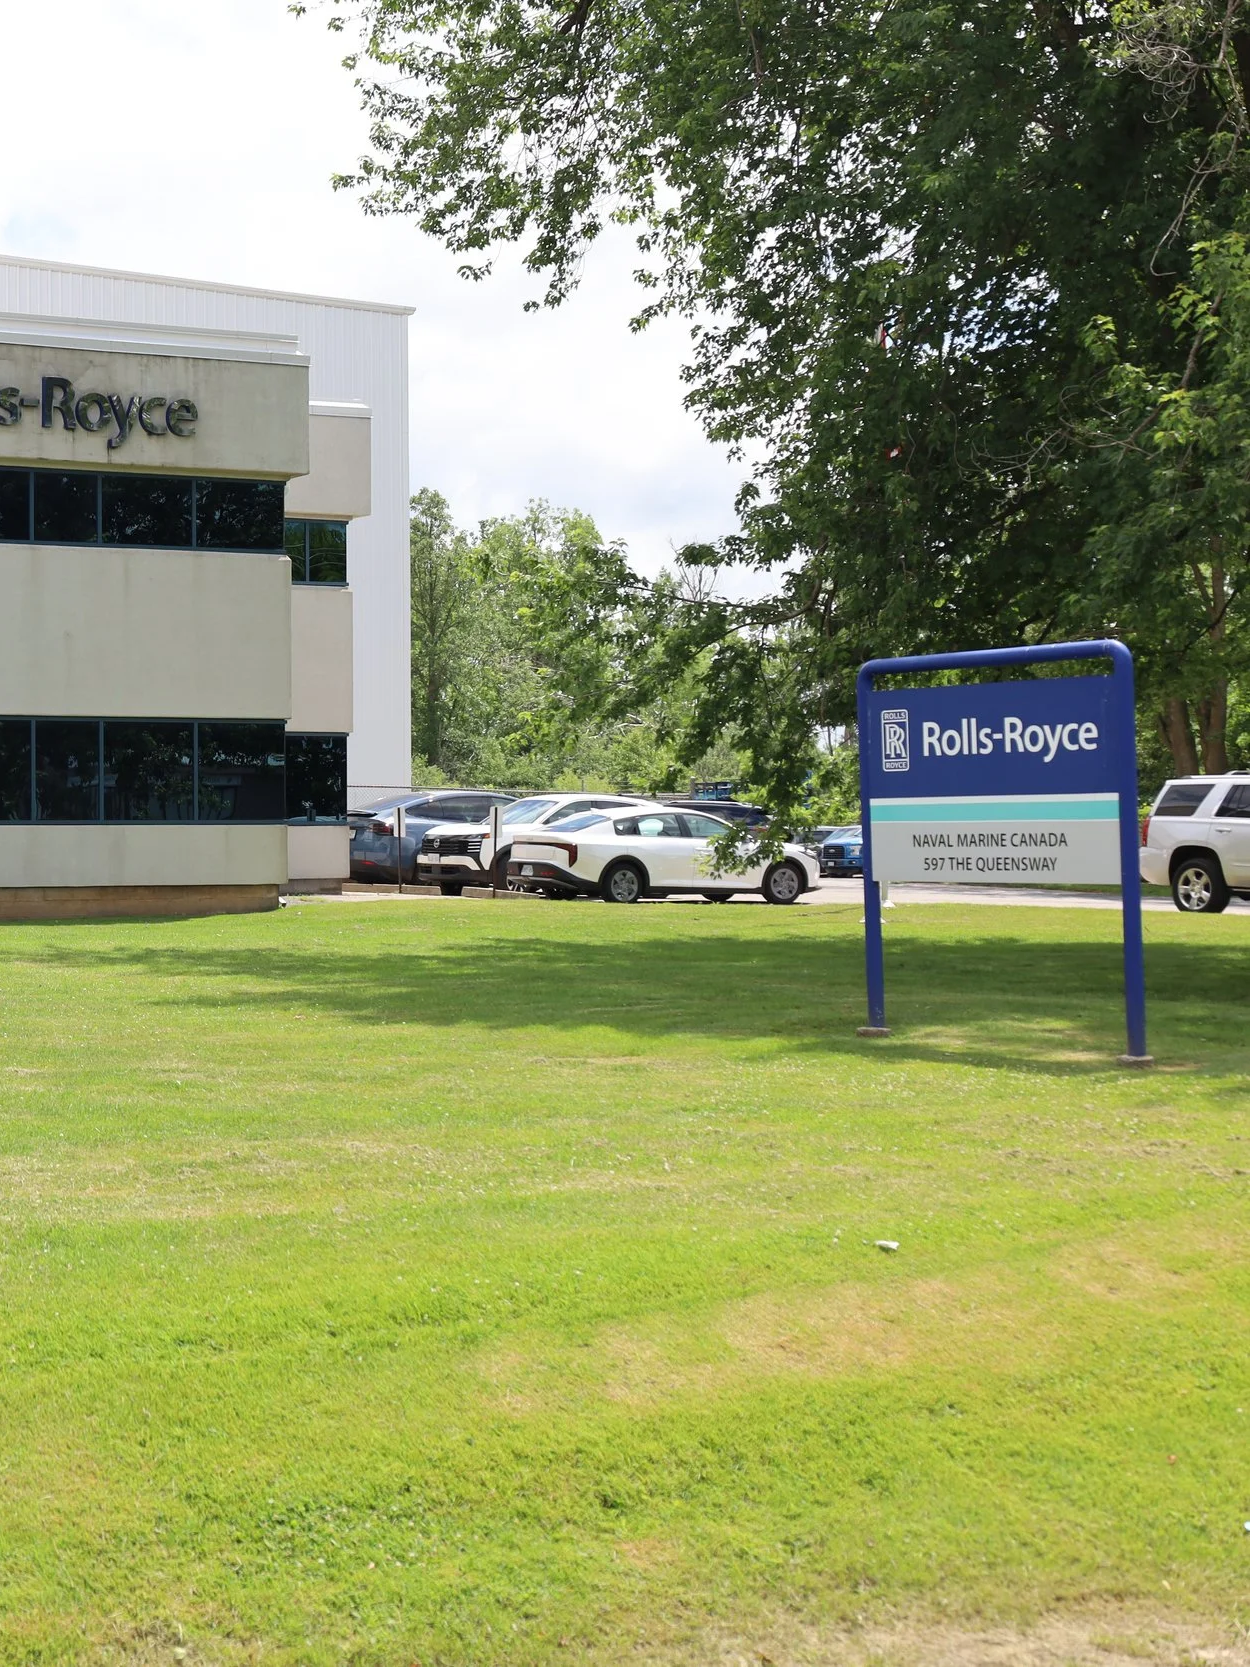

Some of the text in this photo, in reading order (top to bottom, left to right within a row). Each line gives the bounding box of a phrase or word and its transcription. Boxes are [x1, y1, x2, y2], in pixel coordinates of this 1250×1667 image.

[884, 712, 905, 720] ROLLS
[922, 717, 1098, 763] Rolls-Royce
[912, 832, 1068, 848] NAVAL MARINE CANADA
[923, 857, 1058, 872] 597 THE QUEENSWAY
